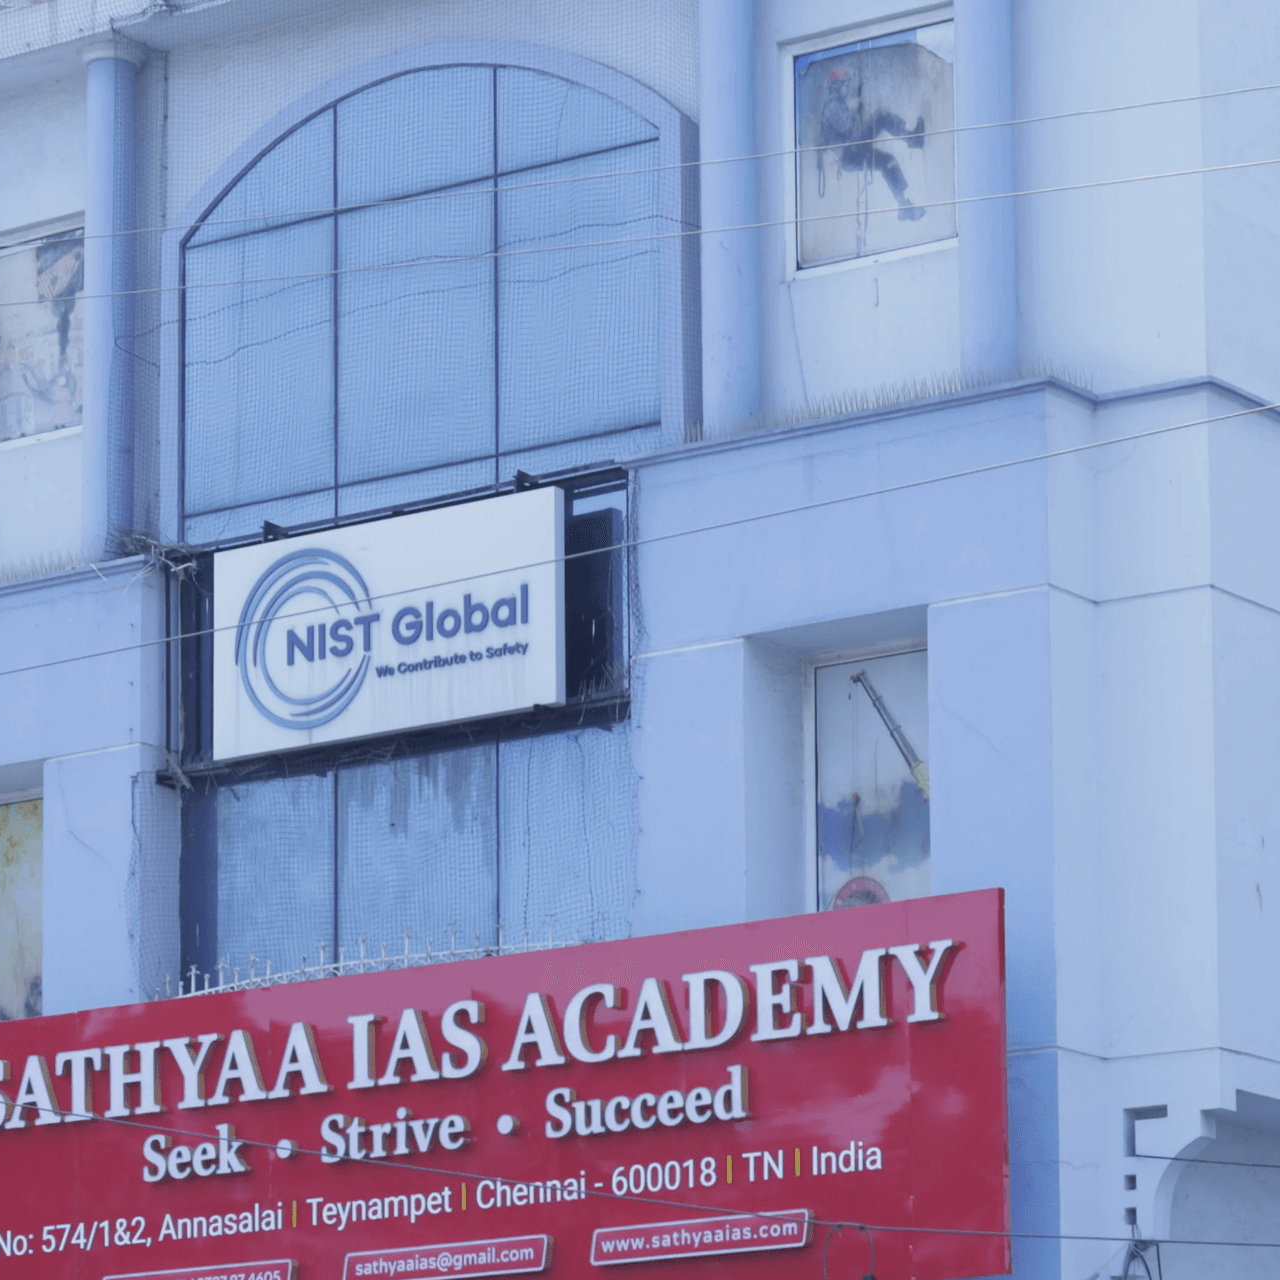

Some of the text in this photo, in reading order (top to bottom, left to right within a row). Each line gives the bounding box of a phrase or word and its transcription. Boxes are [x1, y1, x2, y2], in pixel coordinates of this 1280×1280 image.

[286, 583, 529, 667] NIST Global
[375, 641, 529, 679] We Contribute to Safety
[346, 999, 488, 1090] IAS
[501, 938, 960, 1071] ACADEMY
[143, 1065, 749, 1183] Seek Strive Succeed
[41, 1216, 152, 1253] 574/1&2,
[157, 1200, 283, 1242] Annasalai
[306, 1186, 452, 1231] Teynampet
[477, 1169, 586, 1210] Chennai
[611, 1156, 717, 1196] 600018
[742, 1149, 784, 1182] TN
[812, 1141, 883, 1176] India
[601, 1221, 798, 1254] www.sathyaaias.com
[354, 1246, 535, 1278] sathyaaias@gmail.com
